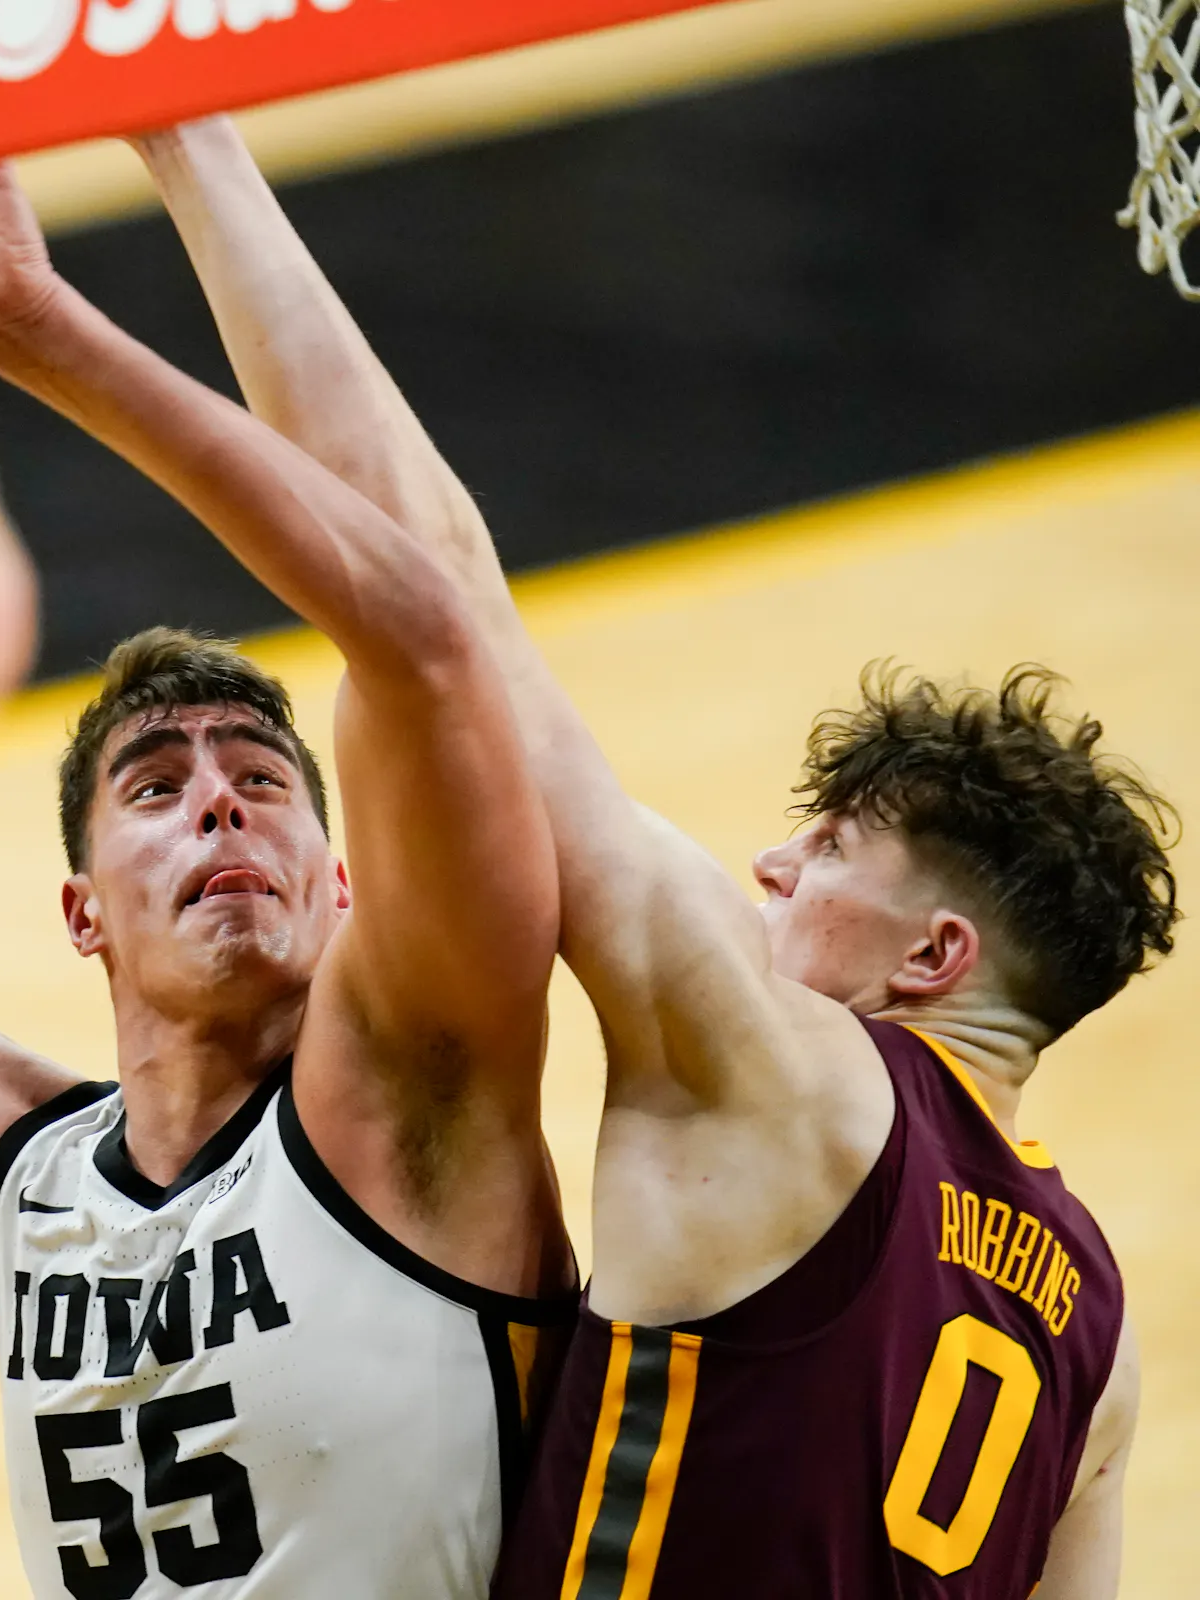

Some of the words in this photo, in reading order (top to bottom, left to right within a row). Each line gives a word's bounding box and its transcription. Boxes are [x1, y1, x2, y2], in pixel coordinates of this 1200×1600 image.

[6, 1227, 291, 1381] IOWA
[938, 1181, 1081, 1337] ROBBINS
[35, 1381, 264, 1600] 55
[883, 1313, 1042, 1577] 0
